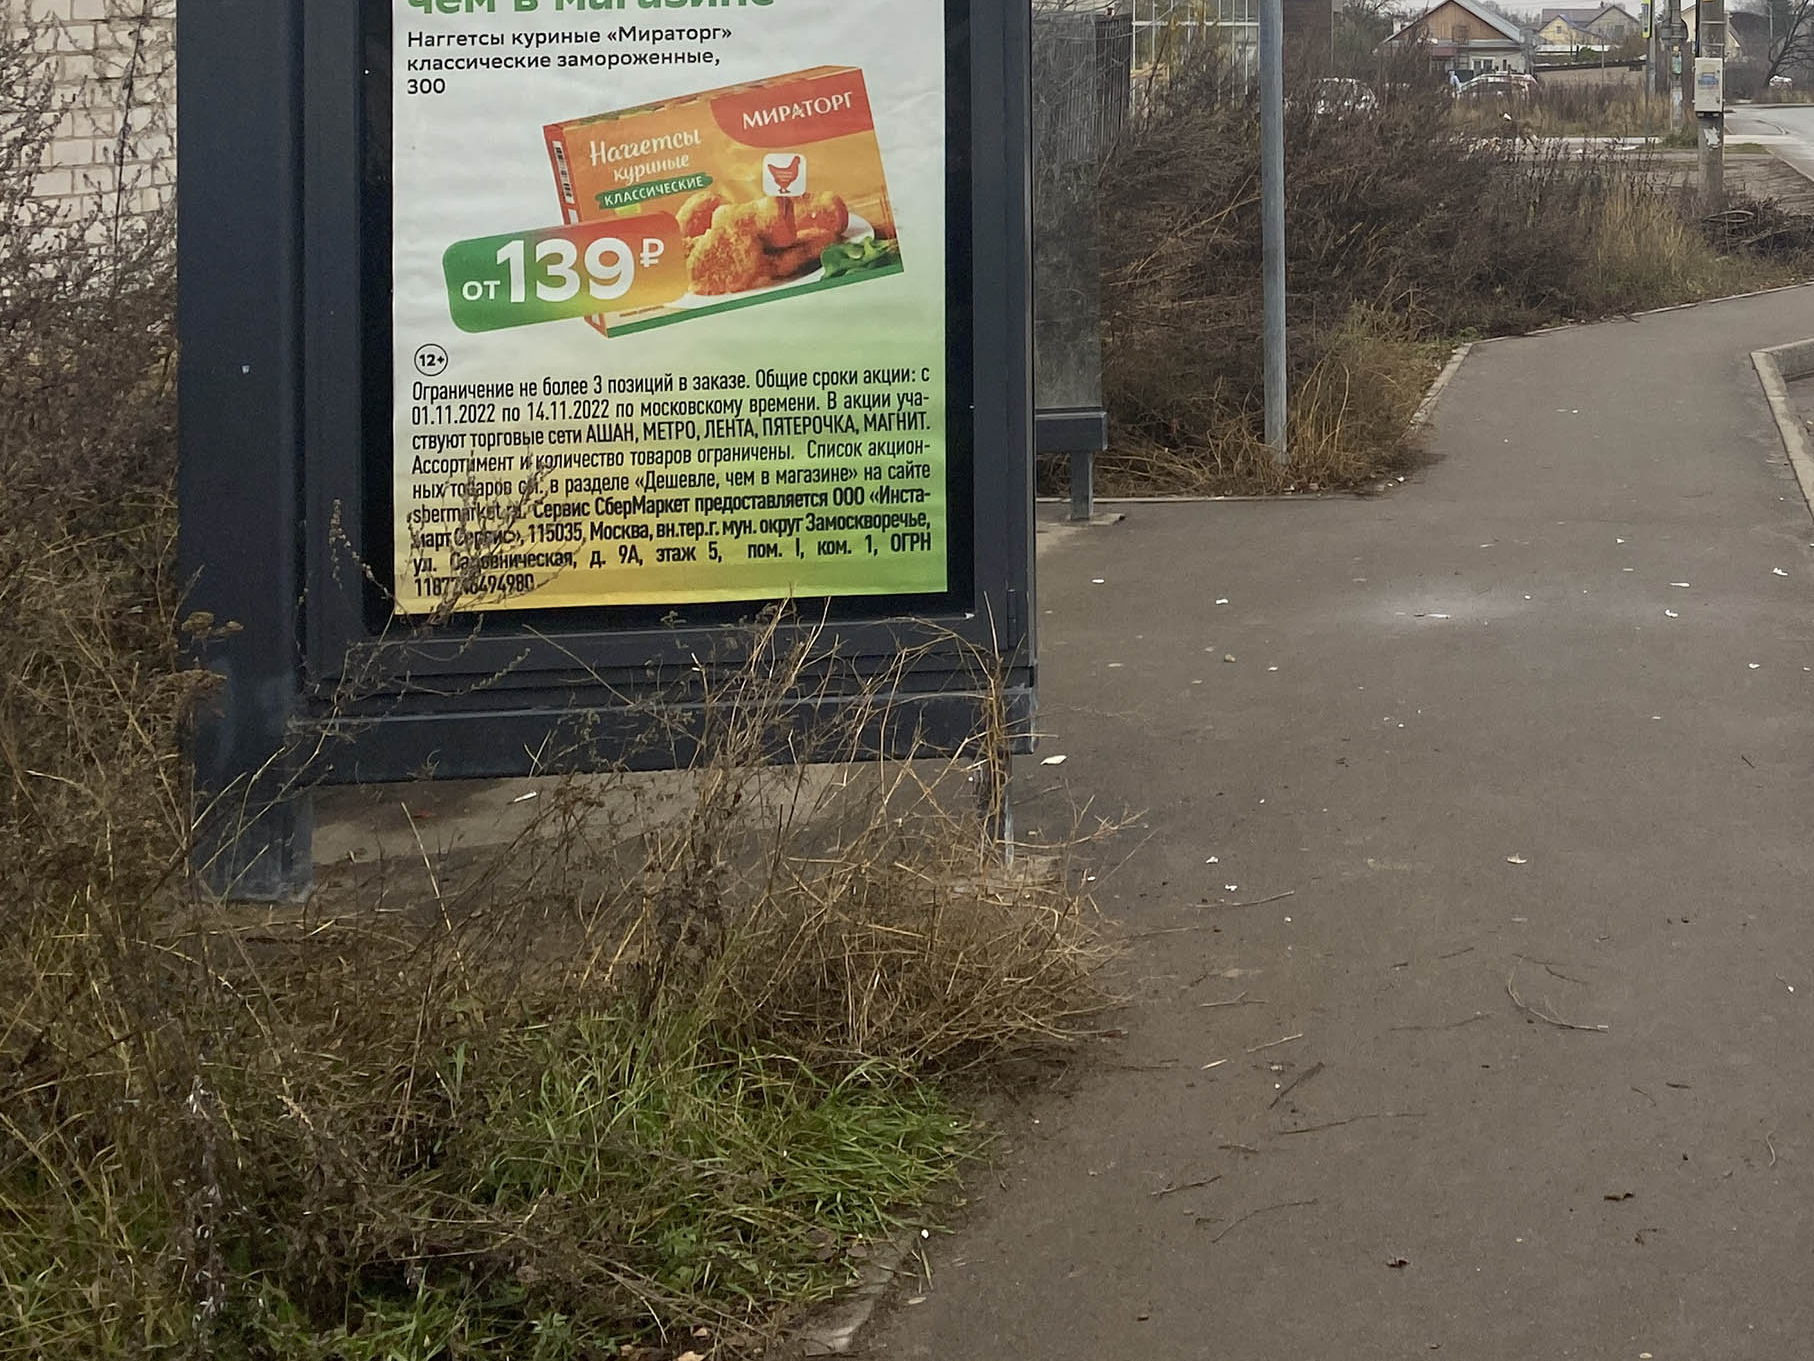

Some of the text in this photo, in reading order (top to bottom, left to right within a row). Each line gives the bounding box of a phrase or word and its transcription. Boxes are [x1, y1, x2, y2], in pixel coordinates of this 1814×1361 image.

[408, 26, 732, 48] Наггетсы куриные «Мираторг»
[407, 51, 720, 71] классические замороженные,
[407, 78, 446, 95] 300
[743, 91, 852, 130] МИРАТОРГ
[590, 129, 701, 167] Наггетсы
[613, 154, 689, 186] куриные
[604, 176, 704, 207] КЛАССИЧЕСКИЕ
[462, 280, 501, 300] от
[418, 353, 446, 367] 12+
[413, 368, 930, 404] Ограничение не более 3 позиций в заказе. Общие сроки акции: с
[412, 391, 929, 425] 01.11.2022 по 14.11.2022 по московскому времени. В акции уча-
[413, 411, 930, 454] ствуют торговые сети АШАН, МЕТРО, ЛЕНТА, ПЯТЕРОЧКА, МАГНИТ.
[536, 451, 624, 471] количество
[630, 449, 691, 469] товаров
[697, 445, 794, 469] ограничены.
[807, 440, 862, 459] Список
[868, 440, 930, 459] акцион-
[413, 483, 445, 499] ных
[450, 481, 512, 501] тоаров
[550, 479, 559, 493] в
[565, 476, 629, 497] разделе
[635, 471, 719, 493] «Дешевле,
[726, 470, 754, 487] чем
[761, 470, 770, 485] в
[776, 467, 858, 485] магазине»
[864, 466, 882, 481] на
[888, 460, 930, 480] сайте
[533, 500, 590, 521] Сервис
[595, 495, 690, 519] СберМаркет
[695, 491, 828, 516] предоставляется
[833, 487, 864, 507] ООО
[869, 485, 930, 504] «Инста-
[590, 521, 653, 542] Москва,
[656, 519, 719, 541] вн.тер.г.
[722, 519, 757, 539] мун.
[760, 517, 804, 538] округ
[805, 511, 930, 533] Замоскворечье,
[413, 557, 436, 577] ул.
[450, 550, 577, 571] Саовническая,
[590, 550, 606, 568] д.
[618, 544, 643, 566] 9А,
[656, 546, 696, 562] этаж
[708, 541, 722, 563] 5,
[748, 542, 782, 559] пом.
[818, 540, 852, 556] ком.
[865, 534, 878, 557] 1,
[891, 532, 931, 553] ОГРН
